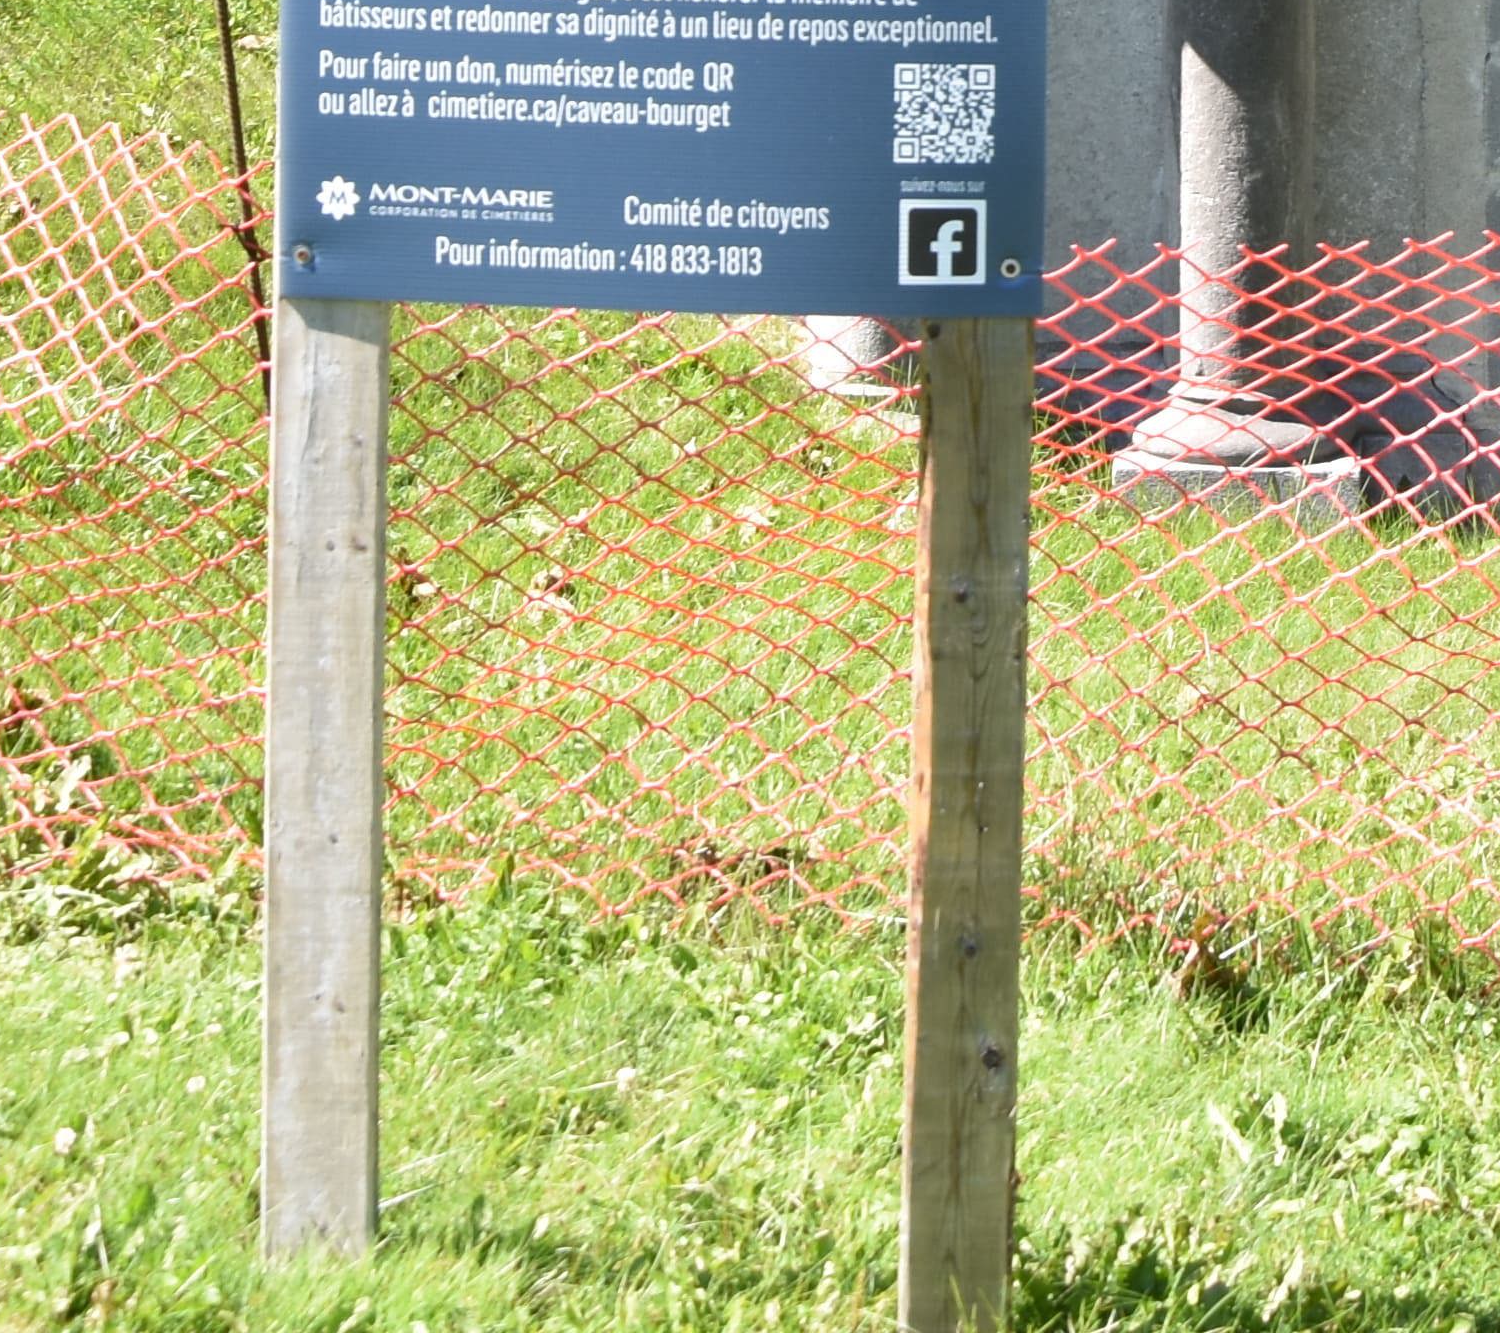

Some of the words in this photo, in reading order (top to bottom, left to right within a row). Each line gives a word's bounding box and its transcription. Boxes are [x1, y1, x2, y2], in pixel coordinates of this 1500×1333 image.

[430, 5, 452, 31] et
[456, 4, 552, 34] redonner
[555, 12, 580, 35] sa
[583, 7, 657, 42] dignité
[662, 8, 676, 39] à
[681, 14, 708, 39] un
[712, 10, 753, 41] lieu
[757, 12, 785, 41] de
[789, 17, 849, 46] repos
[853, 14, 999, 48] exceptionnel.
[319, 49, 369, 79] Pour
[372, 51, 421, 81] faire
[425, 59, 452, 83] un
[455, 55, 501, 87] don,
[505, 57, 614, 89] numérisez
[618, 60, 639, 89] le
[642, 61, 695, 92] code
[702, 62, 735, 93] QR
[318, 92, 345, 116] ou
[348, 88, 398, 117] allez
[401, 89, 415, 117] à
[428, 90, 731, 133] cimetiere.ca/caveau-bourget
[368, 182, 555, 209] MONT-MARIE
[368, 205, 458, 220] CORPORATION
[461, 208, 479, 221] DE
[624, 195, 701, 227] Comité
[706, 199, 733, 228] de
[737, 200, 830, 235] citoyens
[435, 236, 484, 267] Pour
[489, 238, 616, 272] information
[630, 244, 667, 274] 418
[671, 245, 763, 277] 833-1813
